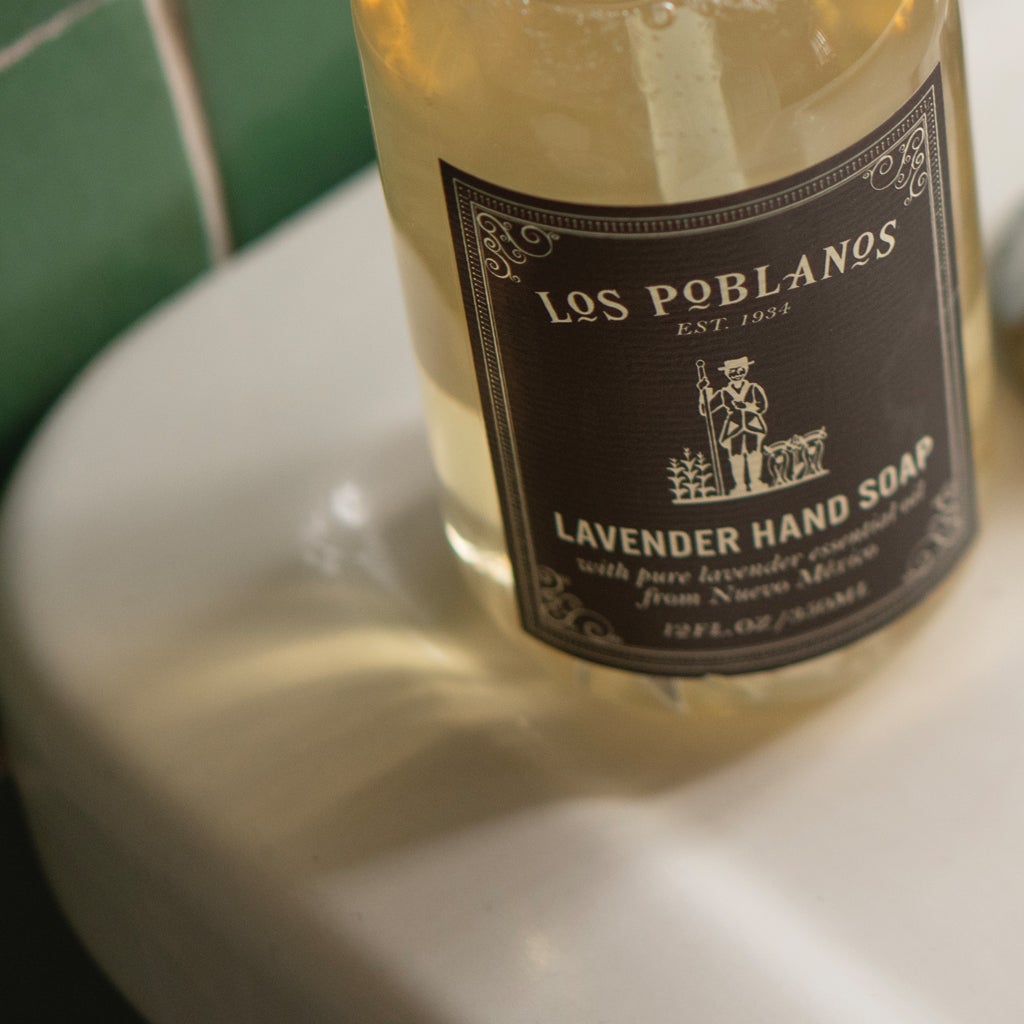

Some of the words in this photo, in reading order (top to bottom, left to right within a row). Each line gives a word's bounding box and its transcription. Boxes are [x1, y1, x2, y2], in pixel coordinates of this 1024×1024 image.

[535, 289, 630, 324] LOS
[645, 218, 898, 317] POBLANOS
[676, 318, 729, 336] EST.
[740, 301, 792, 327] 1934
[554, 511, 741, 558] LAVENDER
[752, 494, 849, 549] HAND
[858, 435, 934, 509] SOAP
[576, 558, 630, 581] with
[635, 567, 692, 588] pure
[699, 553, 804, 584] lavender
[635, 587, 702, 609] from
[709, 580, 790, 606] Nuevo
